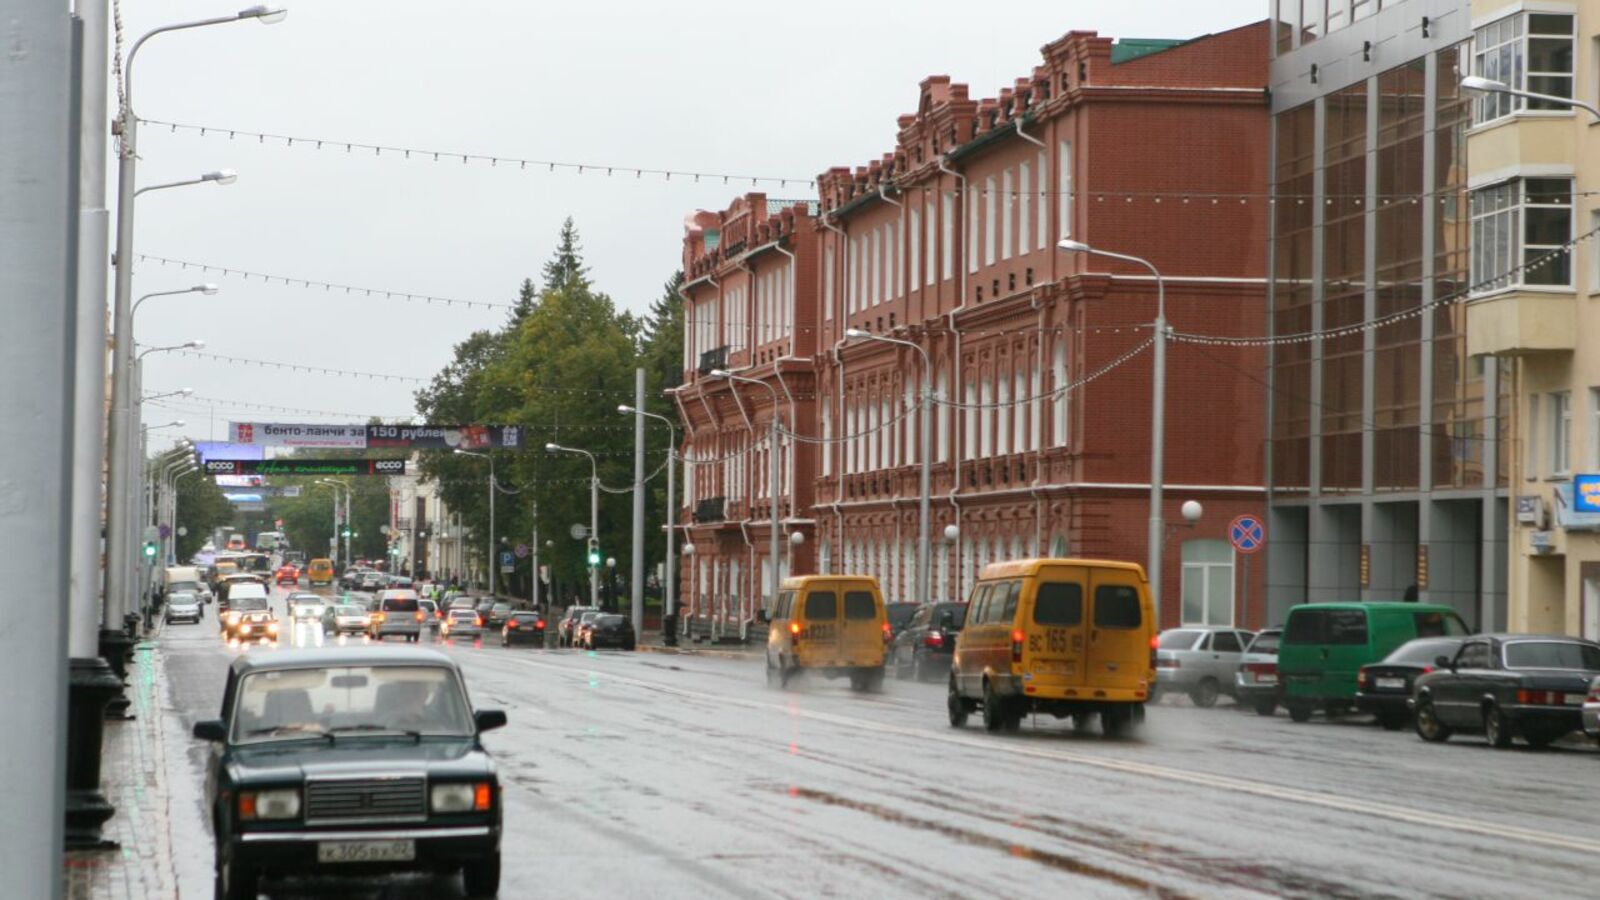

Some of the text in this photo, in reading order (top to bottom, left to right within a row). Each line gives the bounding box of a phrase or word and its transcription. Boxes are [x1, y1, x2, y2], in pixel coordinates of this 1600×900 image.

[264, 425, 345, 437] бенто-ланчи
[351, 428, 365, 437] за
[370, 427, 398, 438] 150
[1045, 628, 1066, 653] 165
